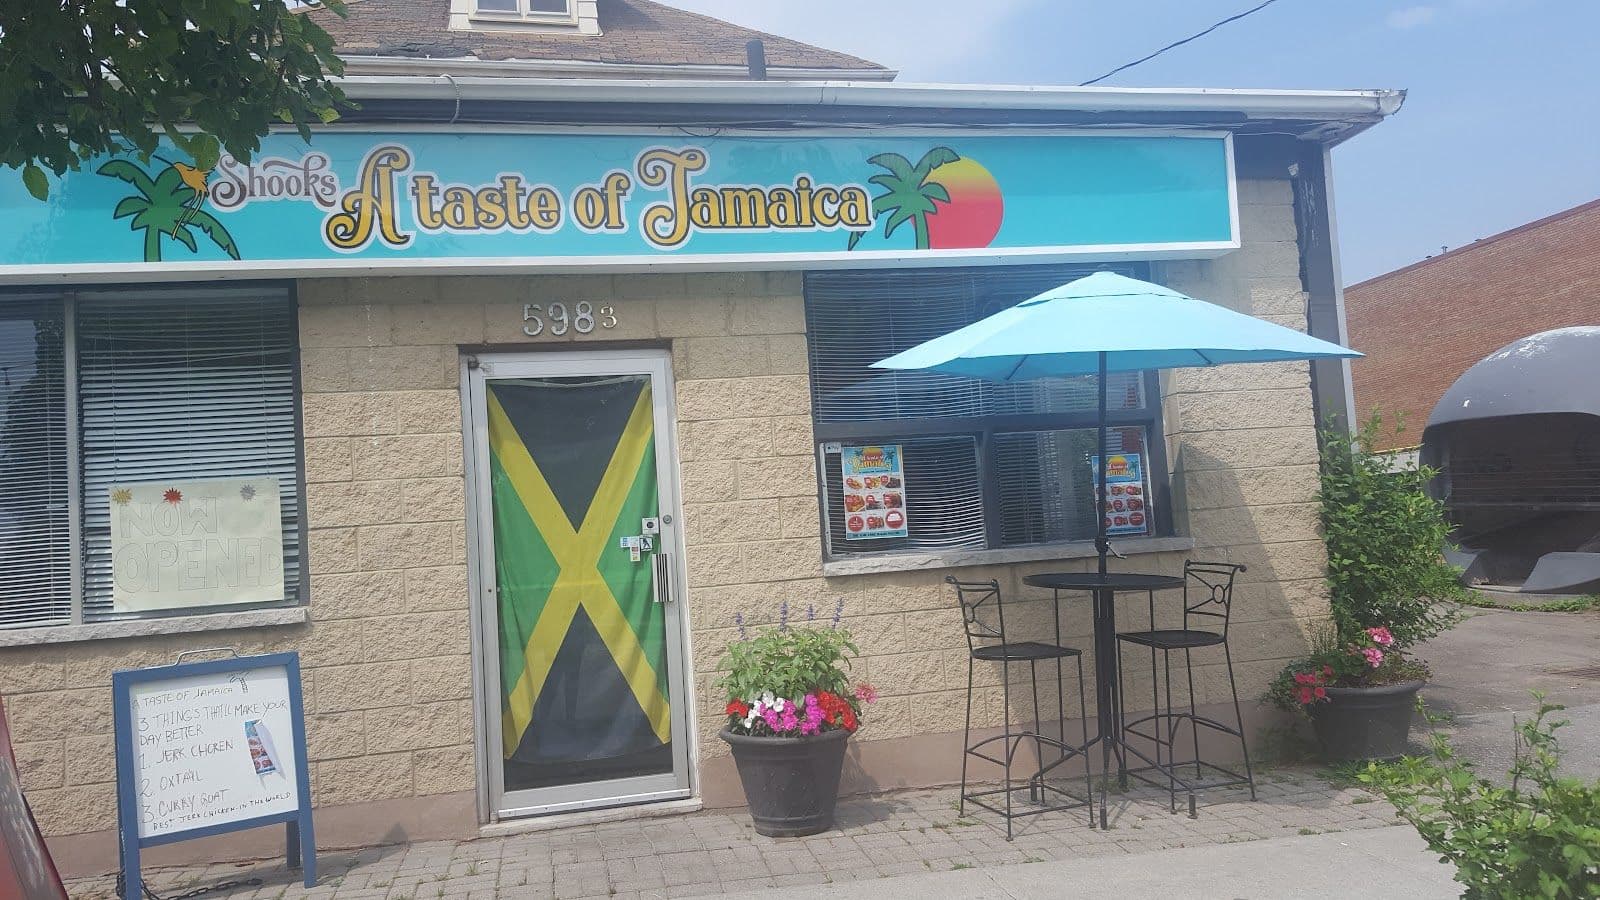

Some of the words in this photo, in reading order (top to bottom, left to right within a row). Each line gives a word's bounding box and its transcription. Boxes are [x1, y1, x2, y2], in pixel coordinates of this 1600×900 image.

[211, 153, 337, 208] Shooks
[326, 145, 411, 249] A
[411, 175, 561, 230] taste
[573, 172, 631, 229] of
[637, 149, 872, 247] Jamaica
[119, 496, 217, 538] NOW
[143, 693, 174, 707] TASTE
[176, 690, 190, 701] OF
[138, 717, 149, 732] 3
[234, 703, 260, 718] MAKE
[262, 699, 288, 718] YOUR
[140, 733, 162, 748] DAY
[165, 724, 204, 743] BETTER
[157, 747, 187, 763] JERK
[158, 795, 195, 817] CURRY
